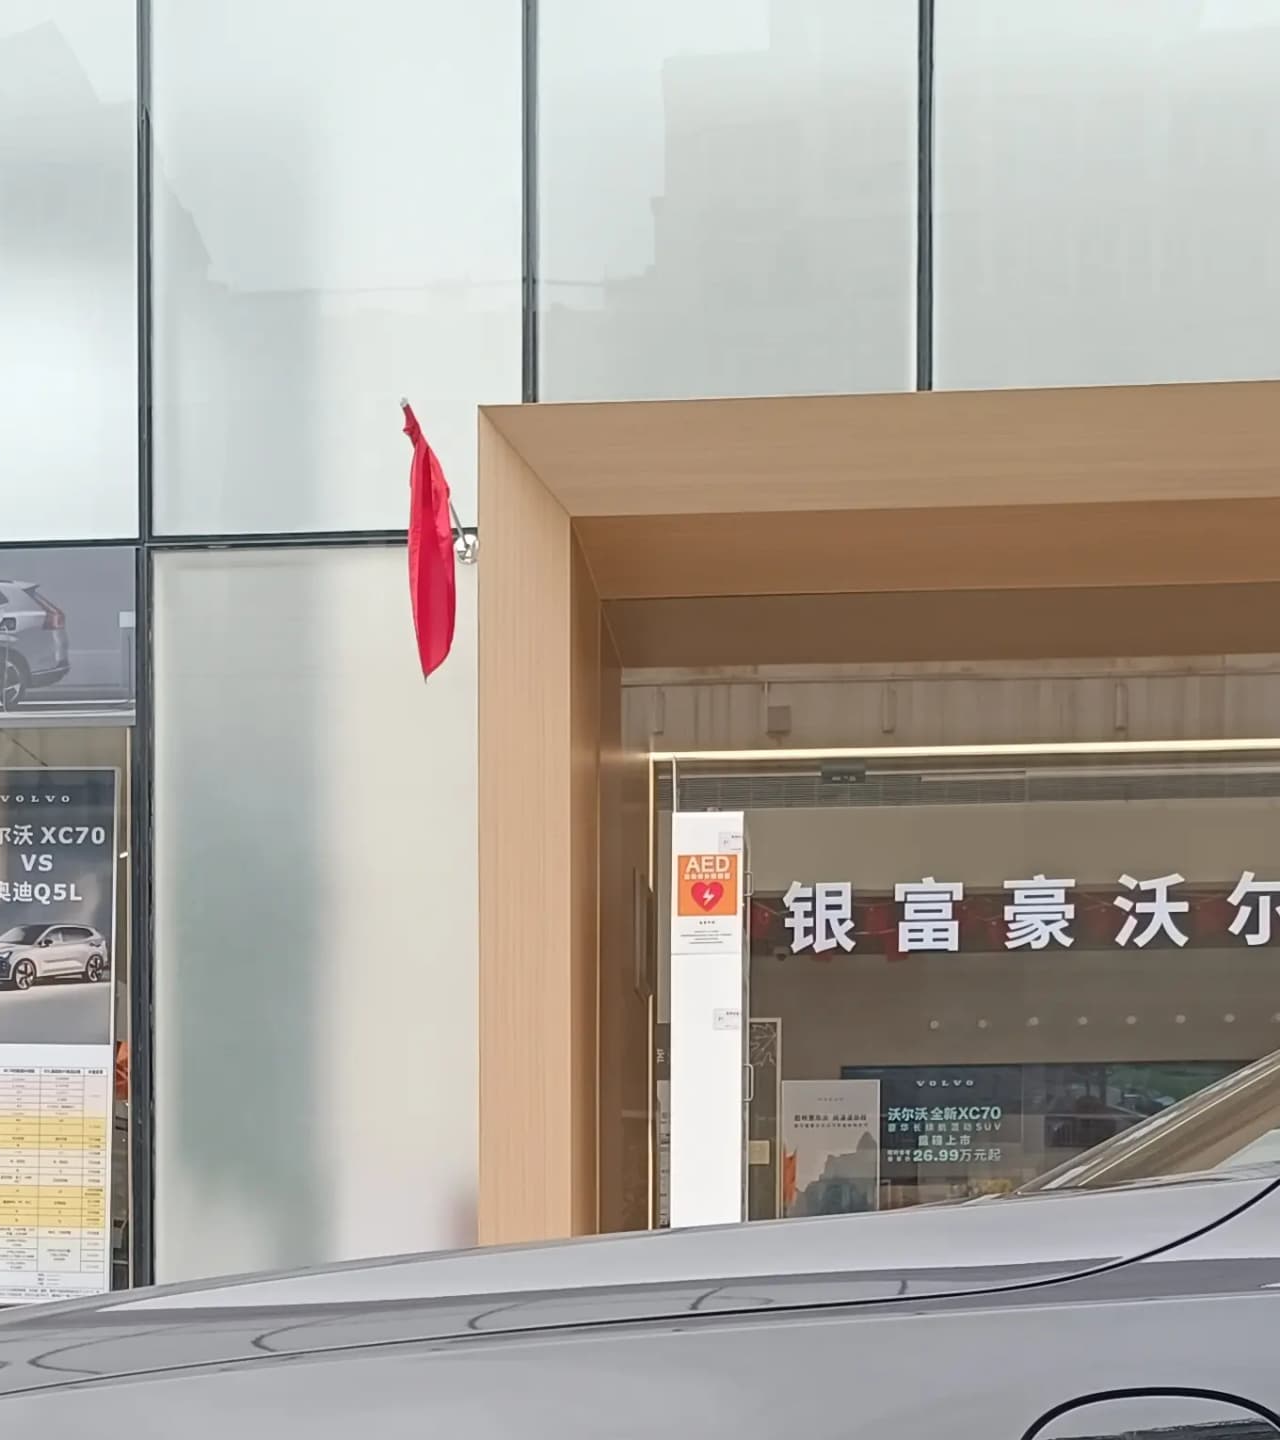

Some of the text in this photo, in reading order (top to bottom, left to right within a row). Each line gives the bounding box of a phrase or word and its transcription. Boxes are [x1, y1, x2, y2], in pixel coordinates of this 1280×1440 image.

[0, 795, 71, 803] VOLVO
[40, 826, 106, 845] XC70
[20, 854, 54, 872] VS
[685, 855, 731, 873] AED
